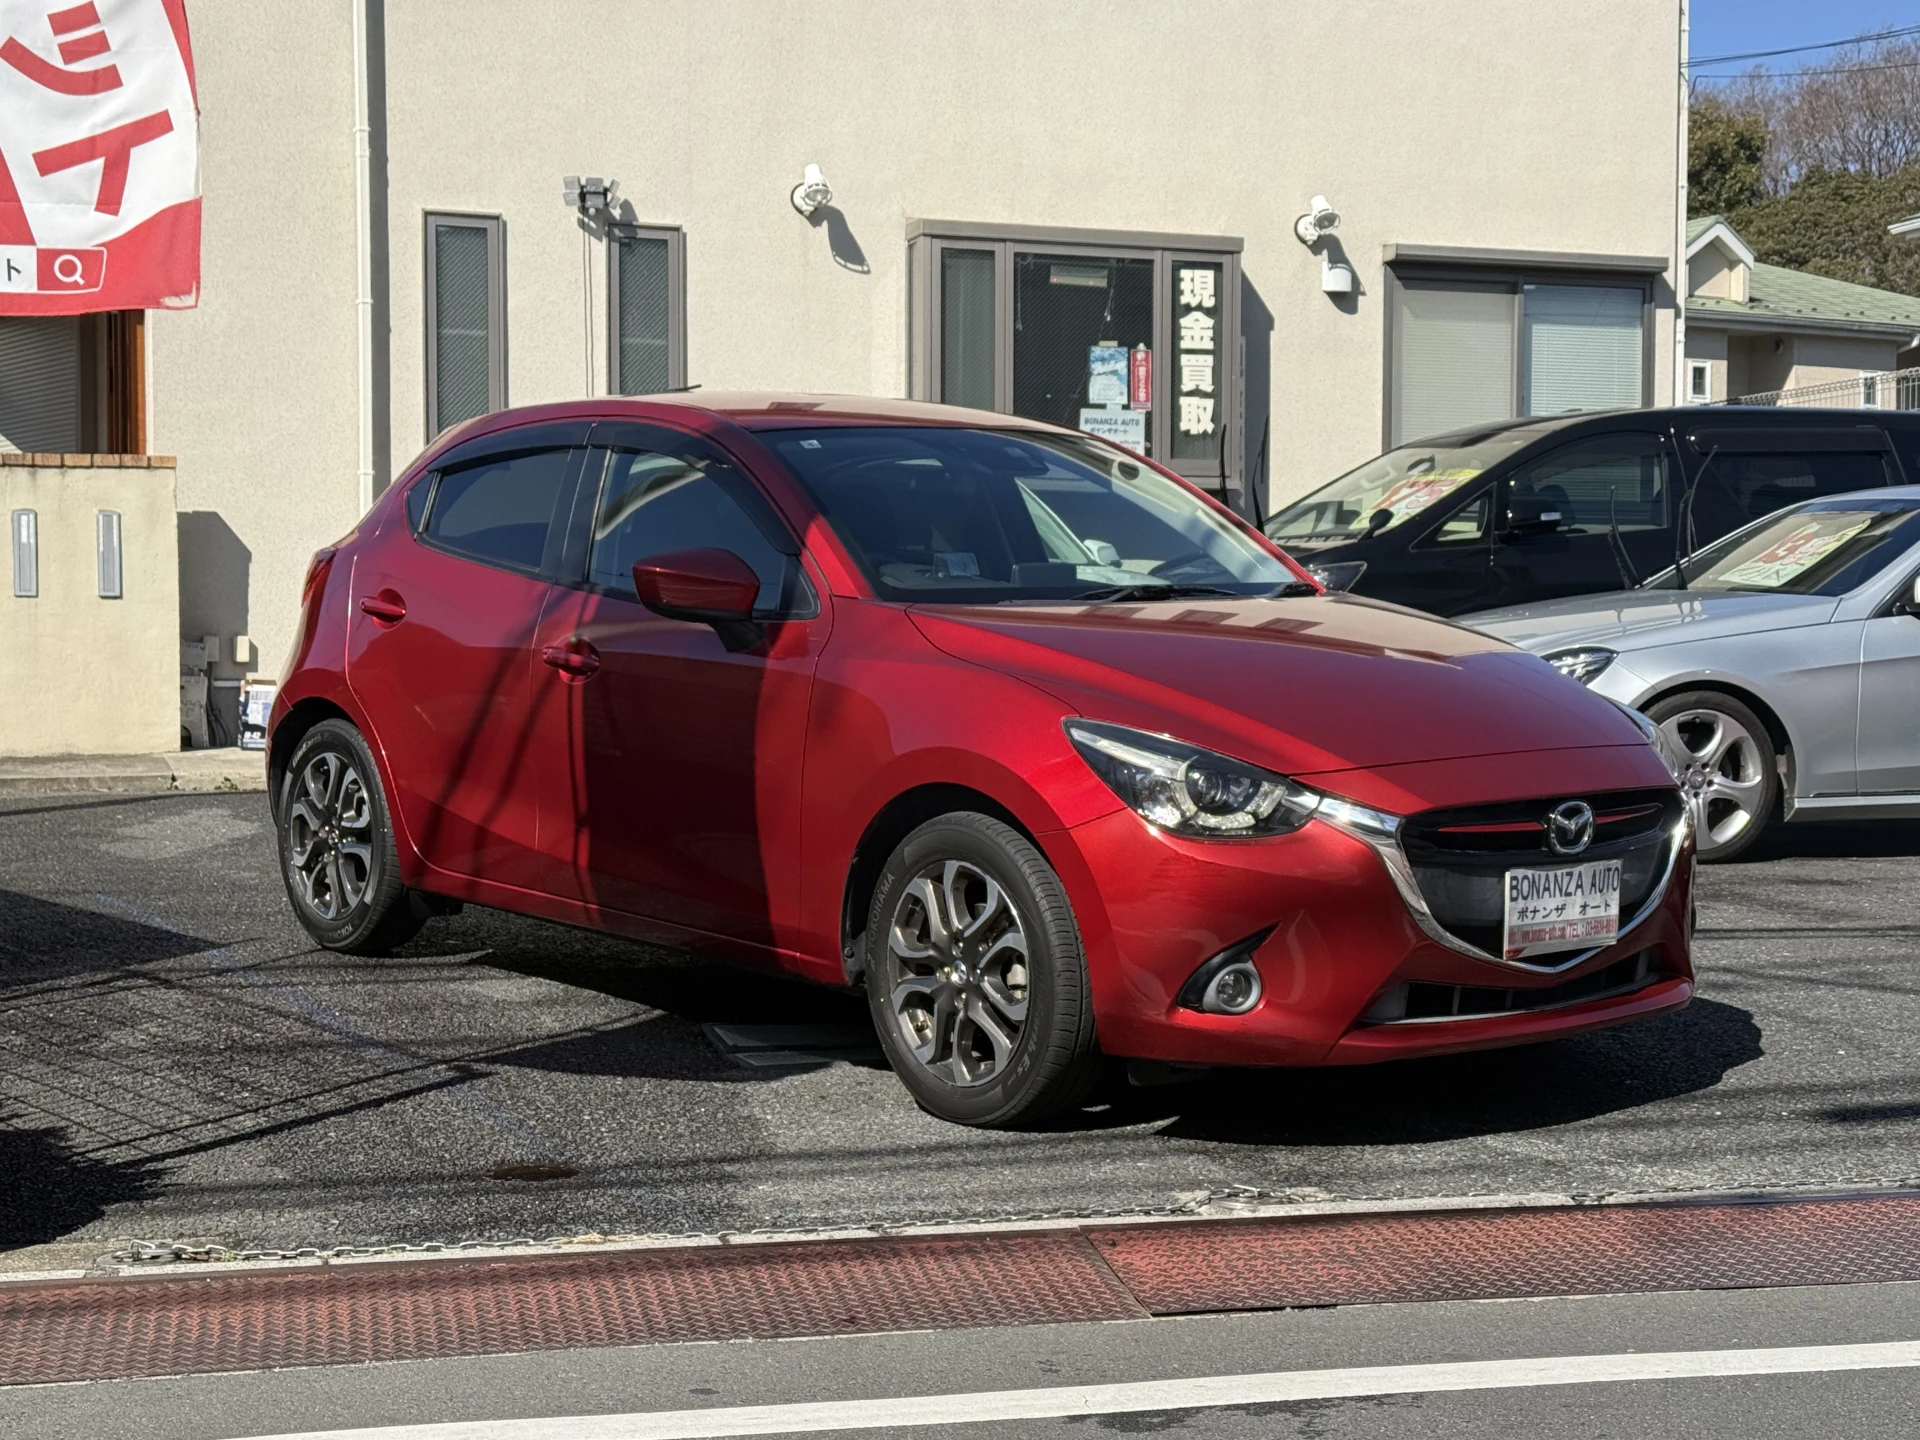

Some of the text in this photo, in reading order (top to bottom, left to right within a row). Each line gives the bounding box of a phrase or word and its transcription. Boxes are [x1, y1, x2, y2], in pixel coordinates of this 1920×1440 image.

[7, 257, 22, 282] ト
[1178, 268, 1217, 436] 現金買取
[1084, 416, 1141, 427] BONANZA AUTO
[1509, 866, 1620, 903] BONANZA AUTO
[867, 872, 895, 949] YOKOHAMA
[1517, 898, 1612, 922] ボナンザ オート
